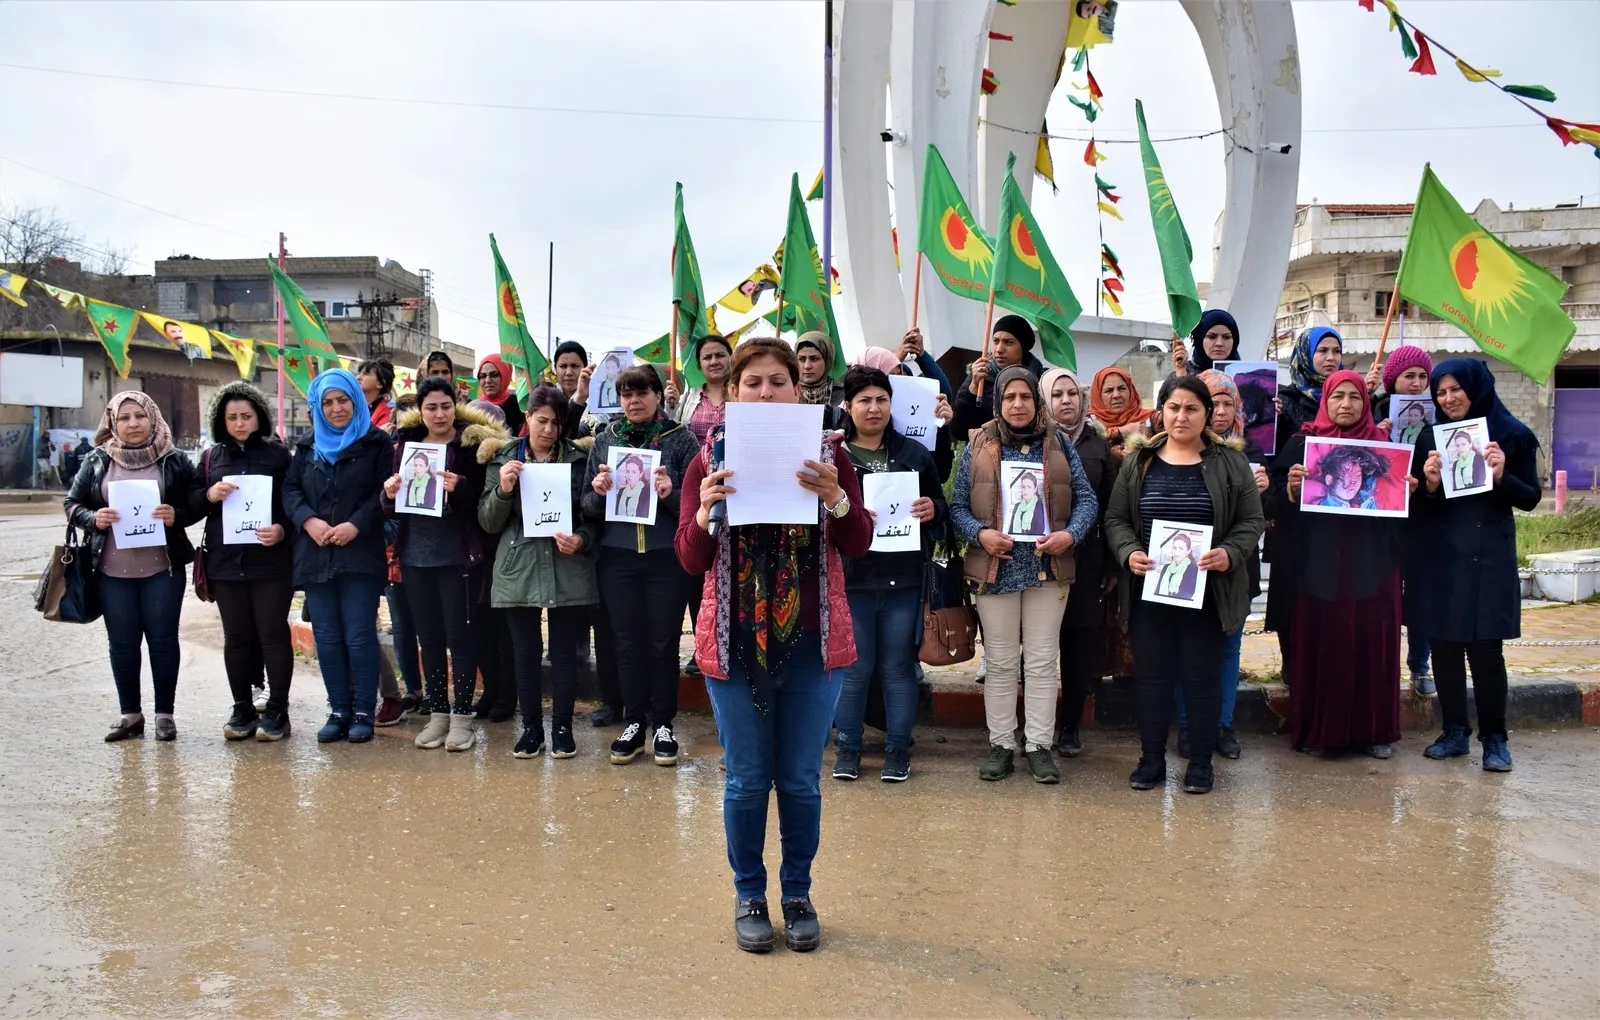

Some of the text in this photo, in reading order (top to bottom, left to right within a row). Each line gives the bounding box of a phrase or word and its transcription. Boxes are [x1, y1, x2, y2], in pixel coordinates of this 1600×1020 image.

[1006, 282, 1052, 306] ngreya
[1484, 335, 1507, 350] Star
[911, 405, 919, 416] لا
[542, 490, 552, 502] لا
[133, 504, 142, 516] لا
[245, 500, 253, 512] لا
[890, 503, 899, 515] لا
[534, 511, 561, 526] للقتل
[125, 524, 156, 536] للعنف
[877, 525, 911, 537] للعنف
